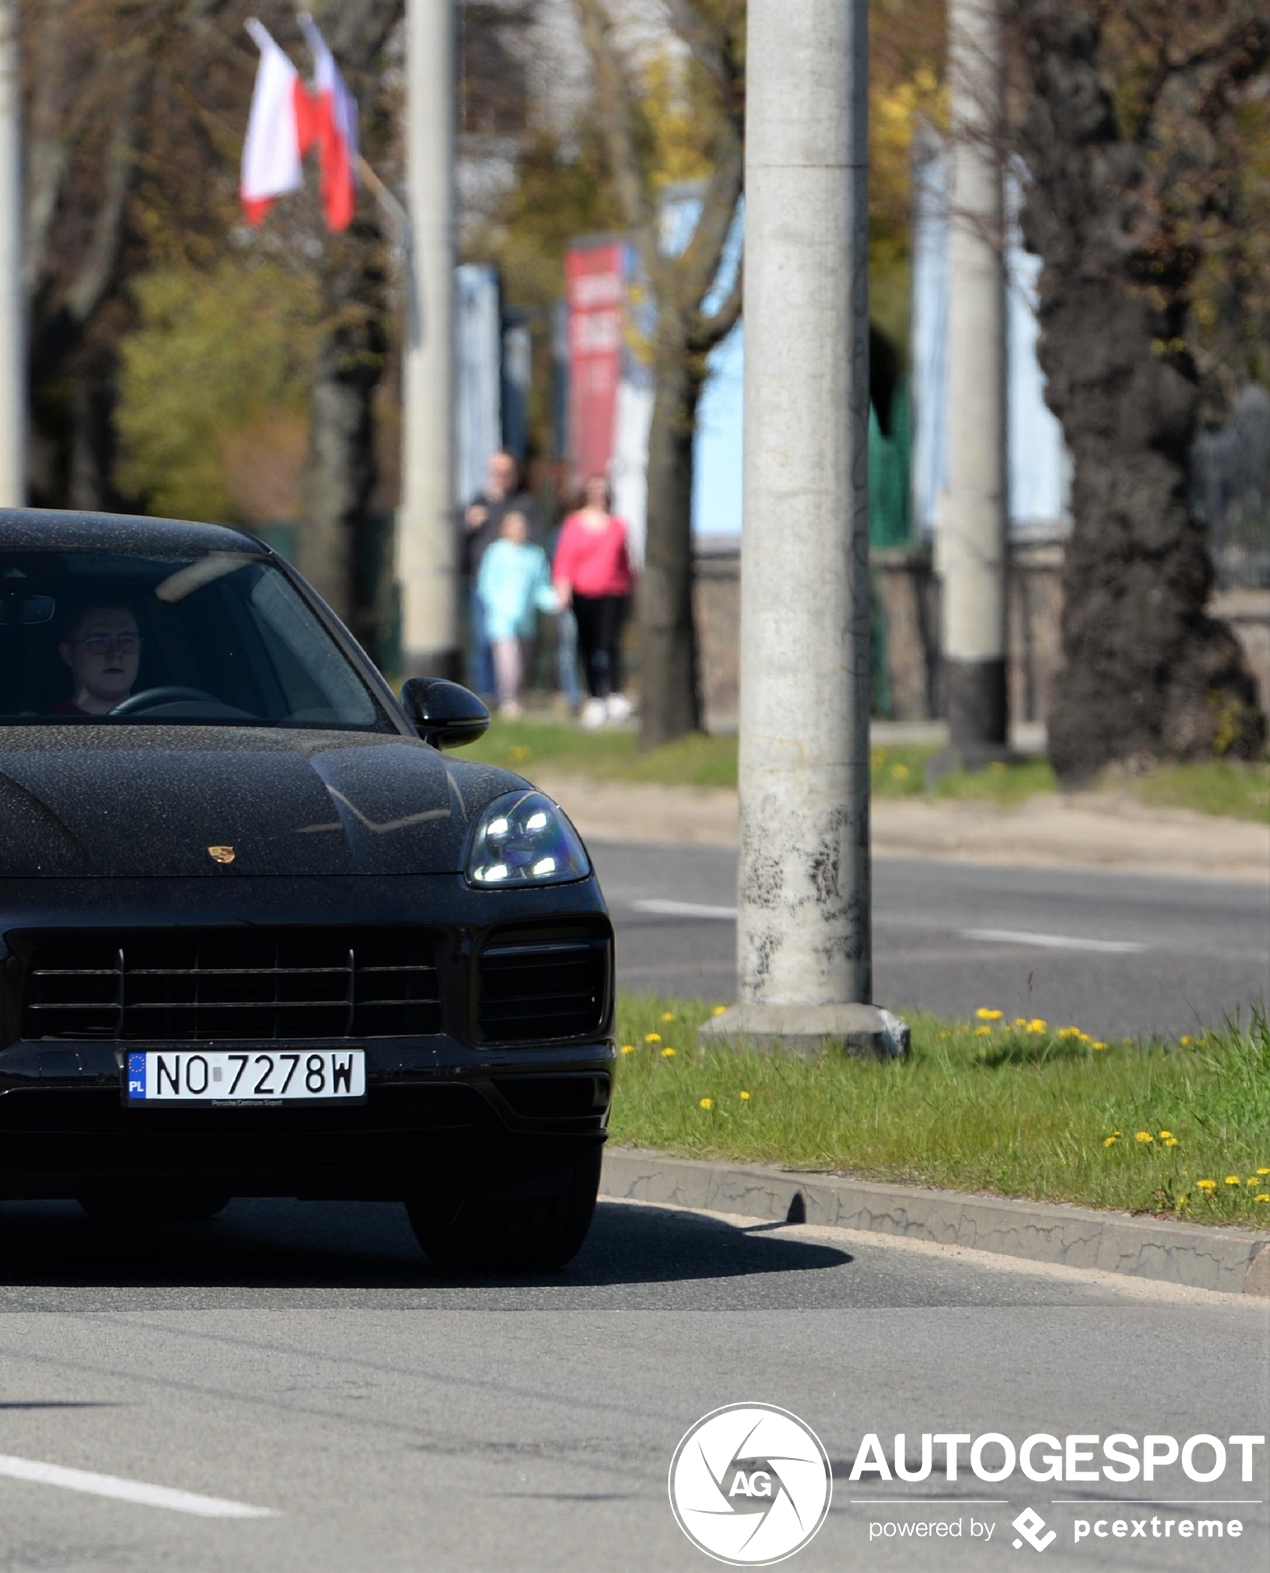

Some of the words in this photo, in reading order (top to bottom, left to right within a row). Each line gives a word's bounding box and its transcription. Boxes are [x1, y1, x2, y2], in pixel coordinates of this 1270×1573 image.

[128, 1081, 144, 1092] PL
[156, 1054, 209, 1095] NO
[227, 1053, 354, 1095] 7278W
